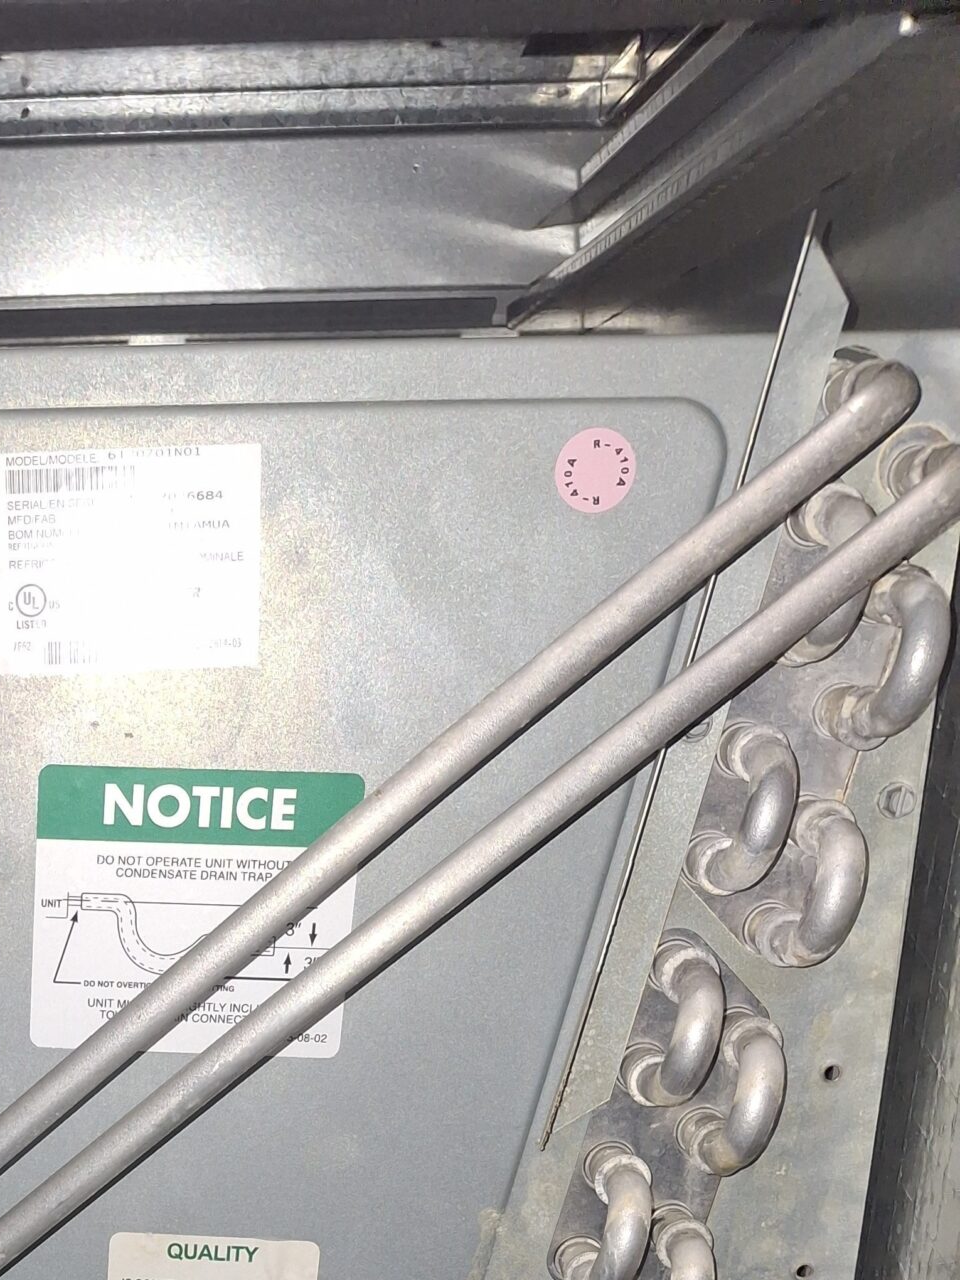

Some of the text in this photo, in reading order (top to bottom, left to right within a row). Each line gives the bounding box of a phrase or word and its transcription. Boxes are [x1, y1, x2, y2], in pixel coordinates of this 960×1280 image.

[593, 439, 630, 487] R-410A
[563, 458, 600, 506] R-410A
[8, 529, 33, 541] BOM
[102, 782, 298, 831] NOTICE
[96, 854, 292, 871] DO NOT OPERATE UNIT WITHOUT
[115, 867, 272, 882] CONDENSATE DRAIN TRAP
[41, 898, 62, 909] UNIT
[83, 980, 96, 988] DO
[88, 998, 115, 1009] UNIT
[167, 1242, 259, 1263] QUALITY
